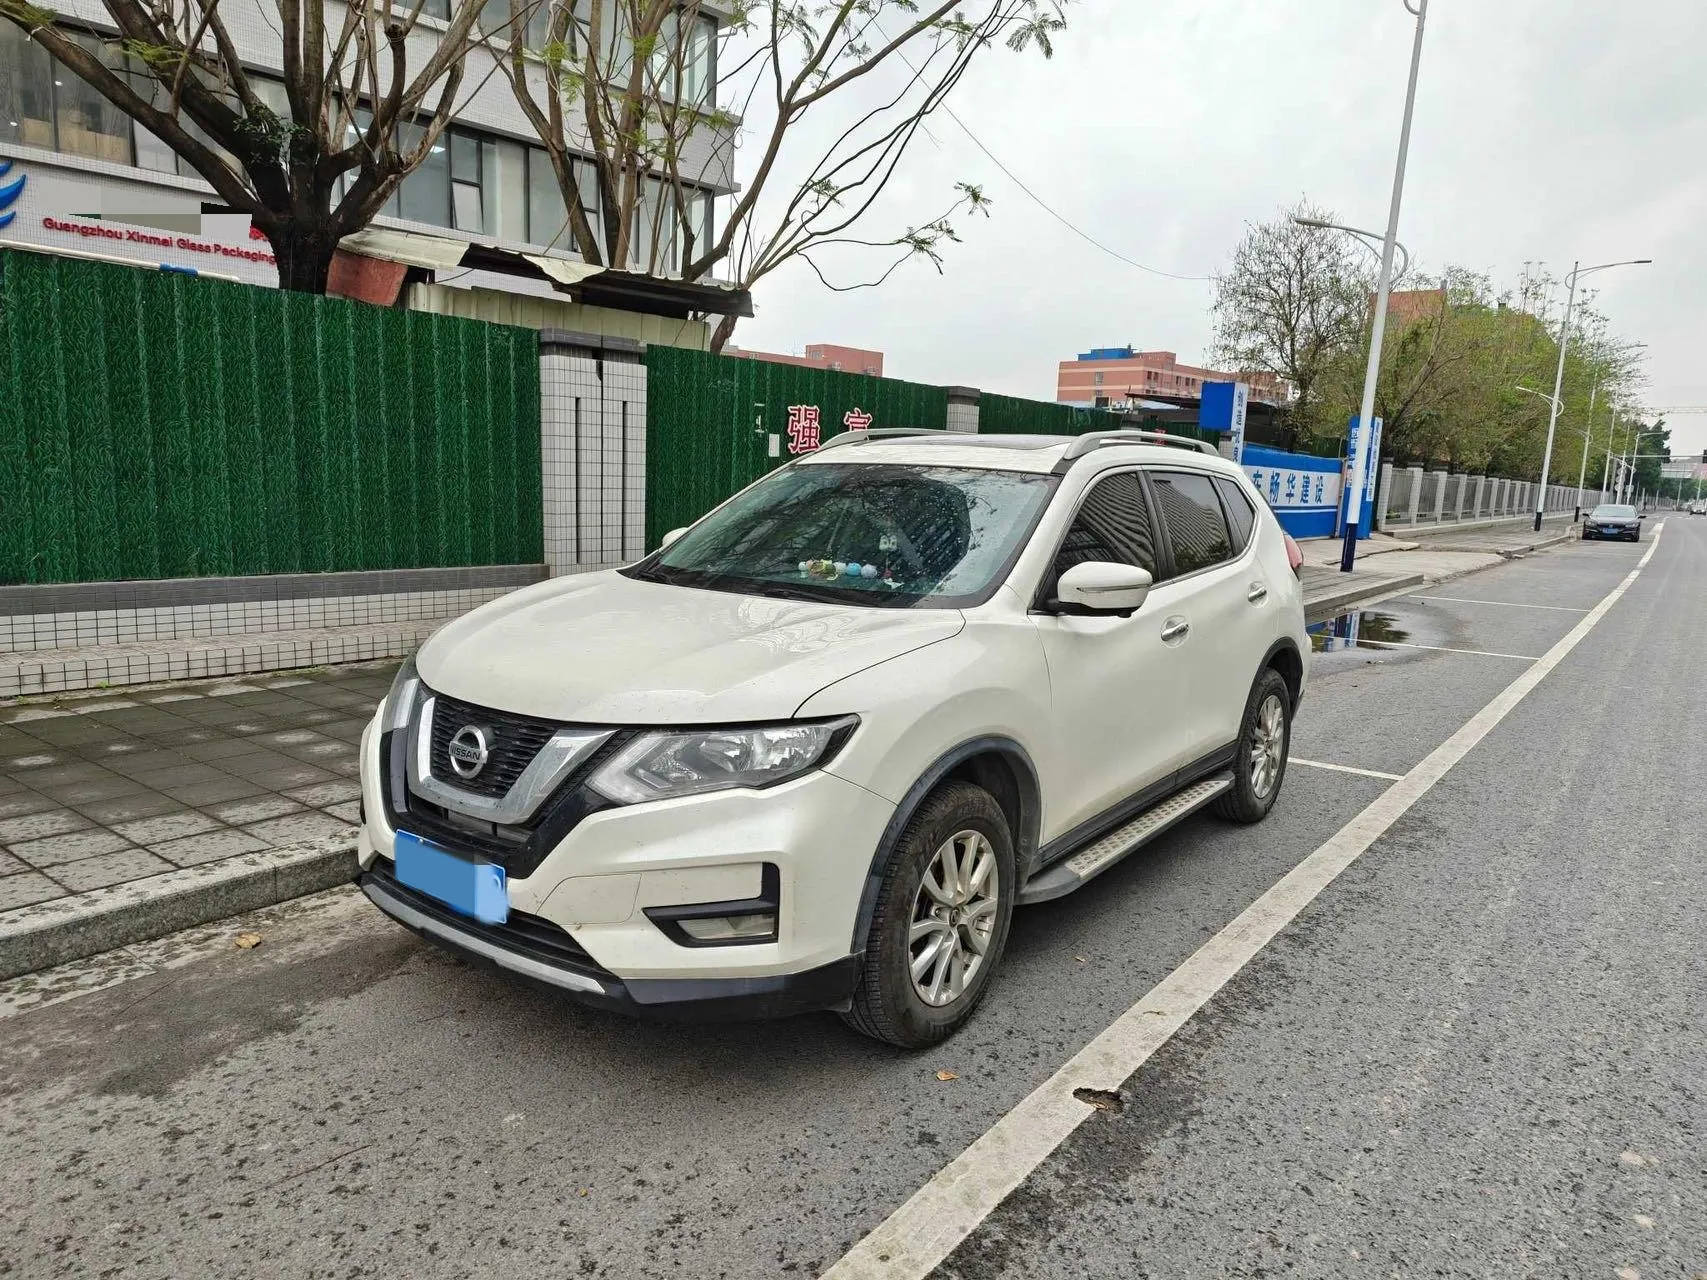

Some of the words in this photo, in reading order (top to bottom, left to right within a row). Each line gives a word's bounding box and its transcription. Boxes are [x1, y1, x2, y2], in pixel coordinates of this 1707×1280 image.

[44, 217, 122, 240] Guangzhou
[127, 230, 172, 248] Xinmai
[176, 238, 211, 254] Glass
[214, 243, 277, 265] Packaging
[450, 745, 481, 761] NISSAN
